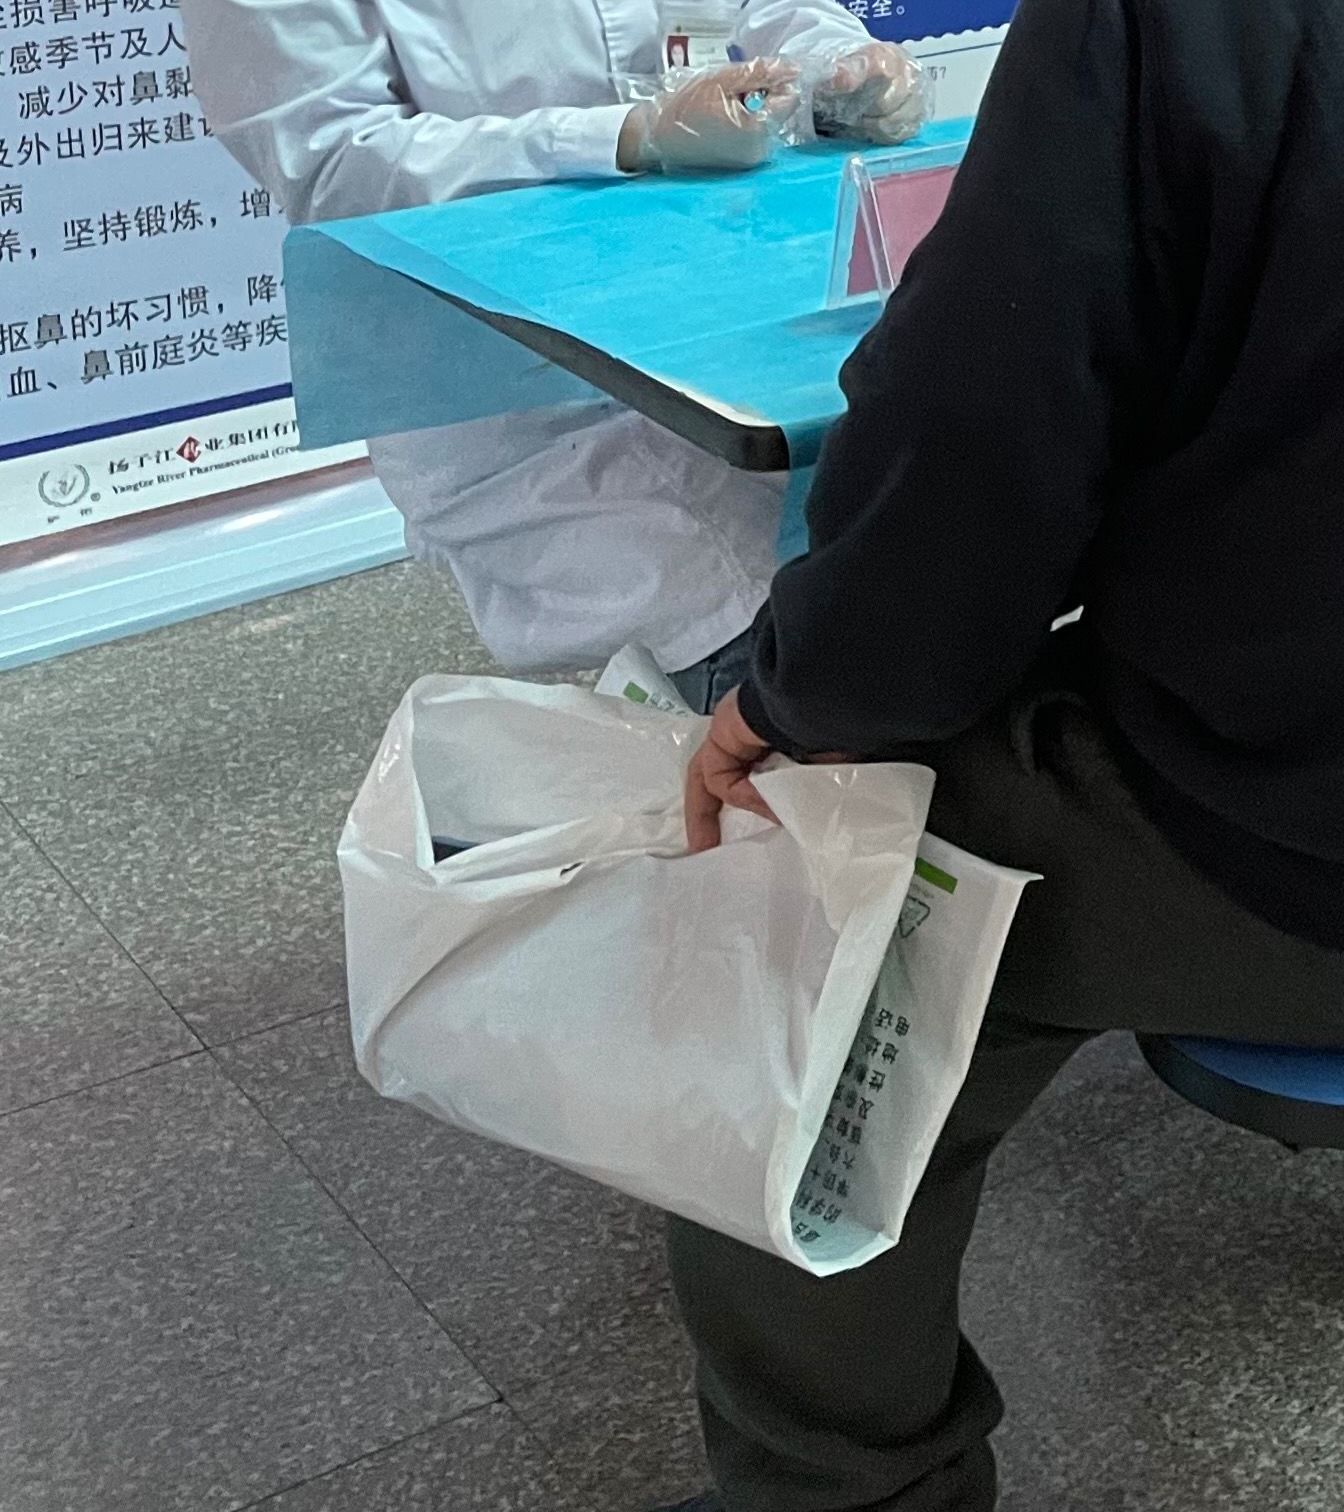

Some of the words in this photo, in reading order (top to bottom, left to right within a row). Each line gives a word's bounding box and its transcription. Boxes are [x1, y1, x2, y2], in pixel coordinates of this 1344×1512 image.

[0, 23, 188, 77] 感季节及人
[0, 273, 286, 355] 抠鼻的坏习惯，降
[111, 478, 154, 495] Yangtze
[157, 471, 187, 485] River
[189, 450, 270, 477] Pharmaceutical
